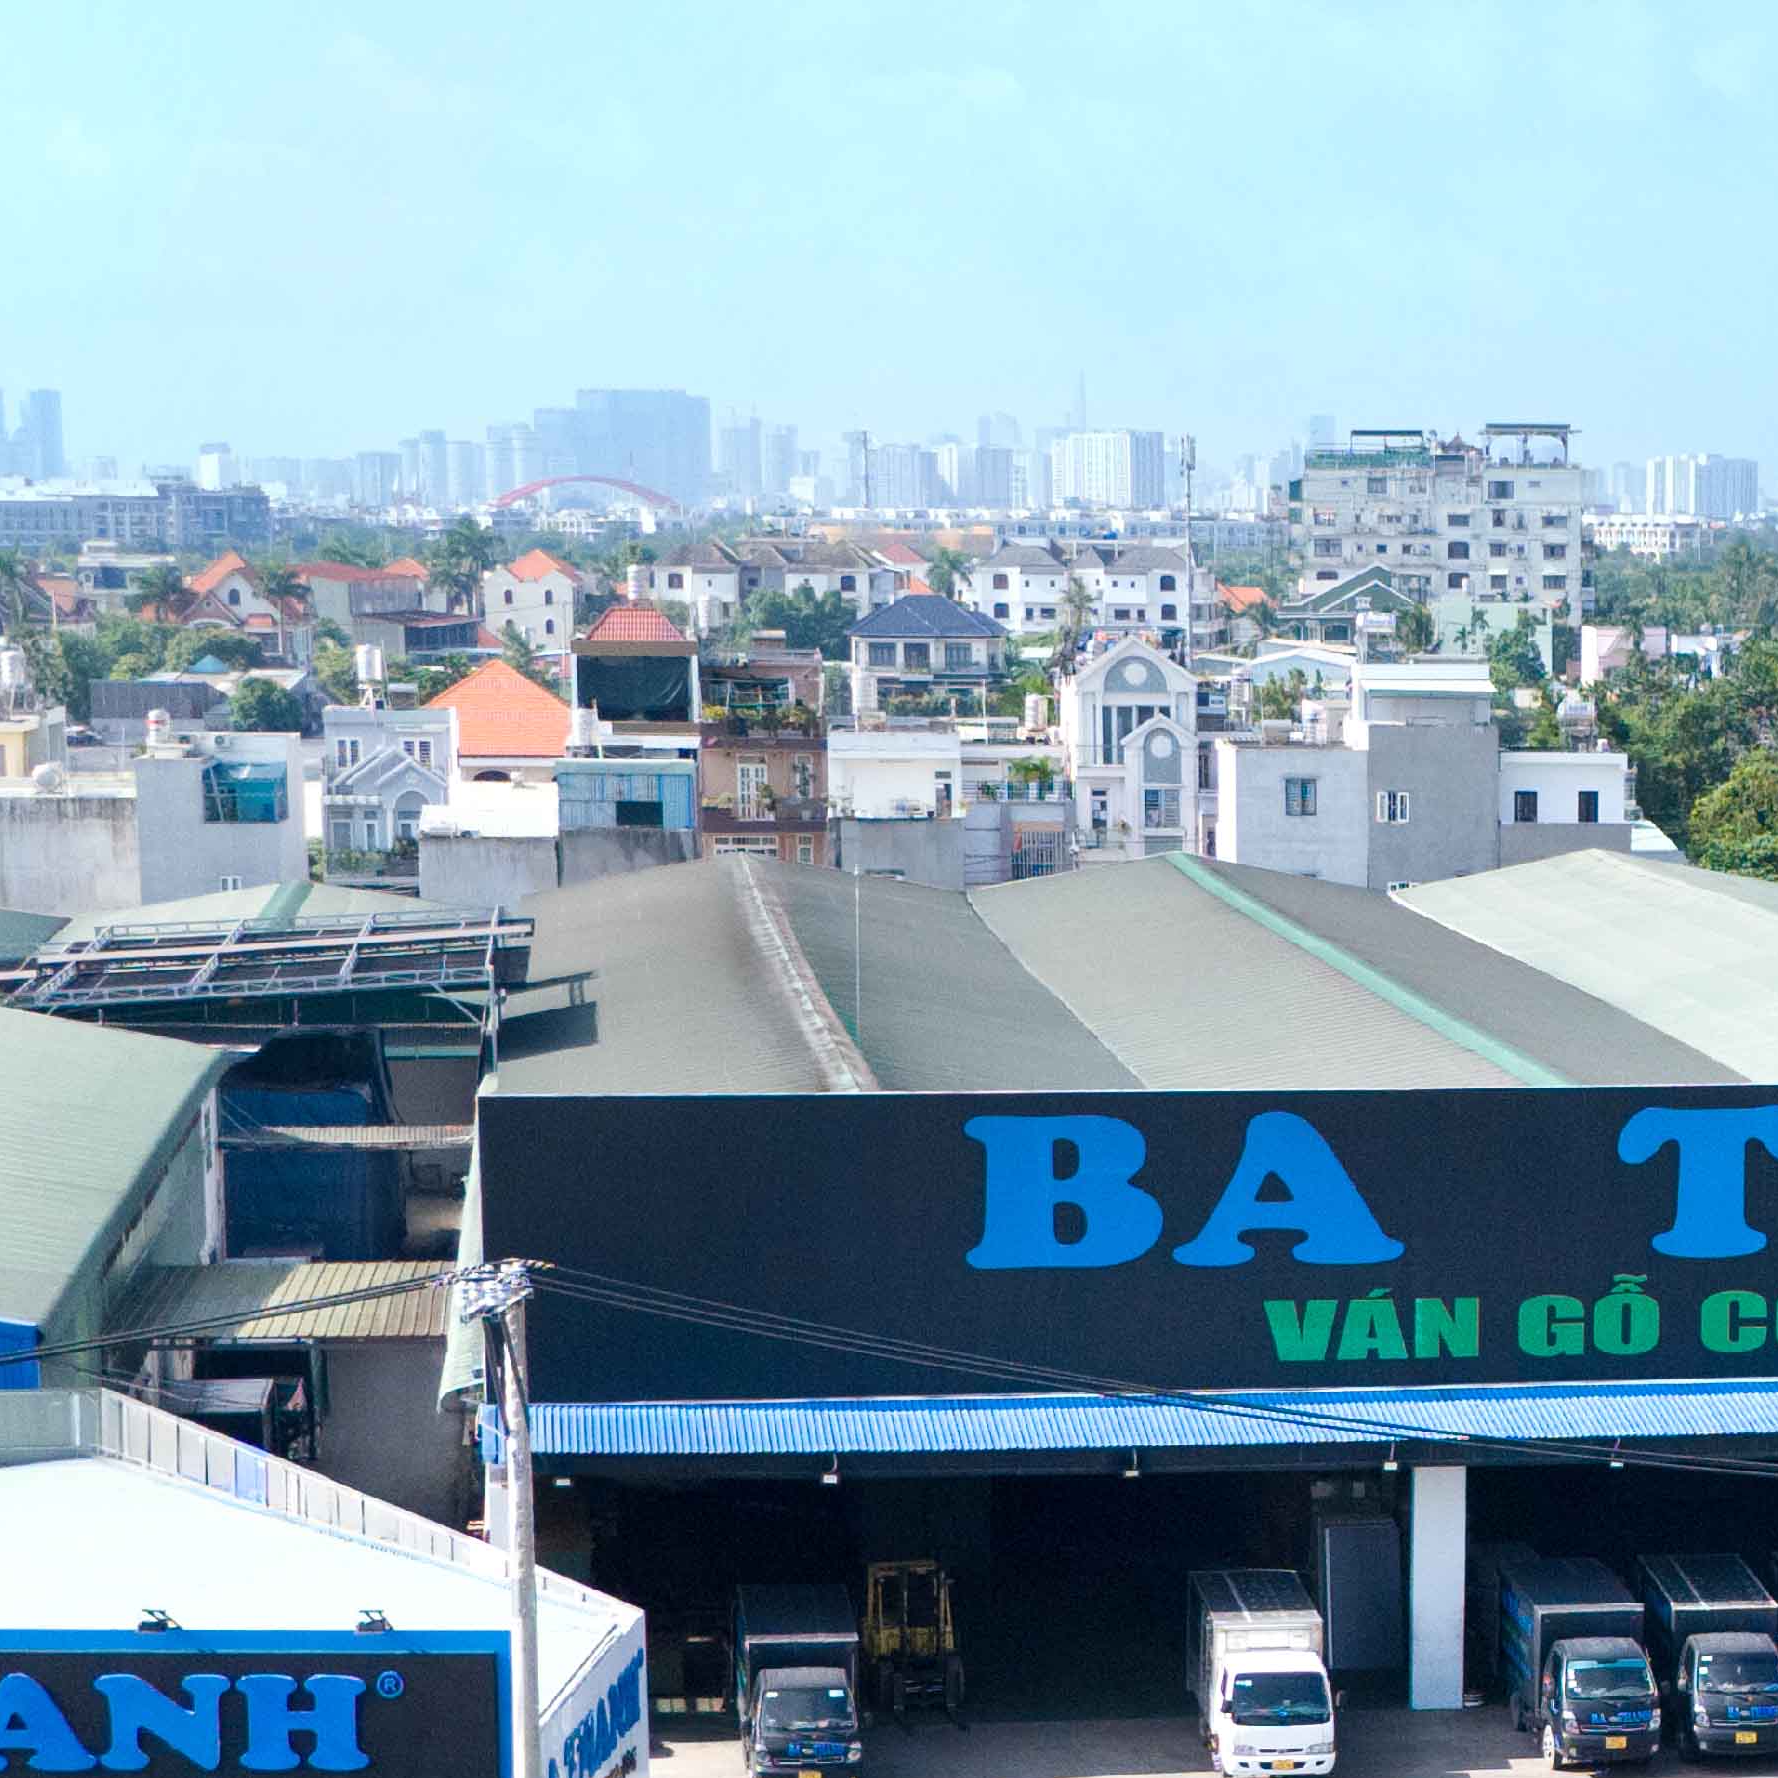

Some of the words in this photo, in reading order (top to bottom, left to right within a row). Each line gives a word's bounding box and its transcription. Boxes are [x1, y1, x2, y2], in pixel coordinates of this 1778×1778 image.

[963, 1111, 1405, 1270] BA
[1263, 1288, 1480, 1362] VÁN
[1517, 1273, 1662, 1357] GỖ
